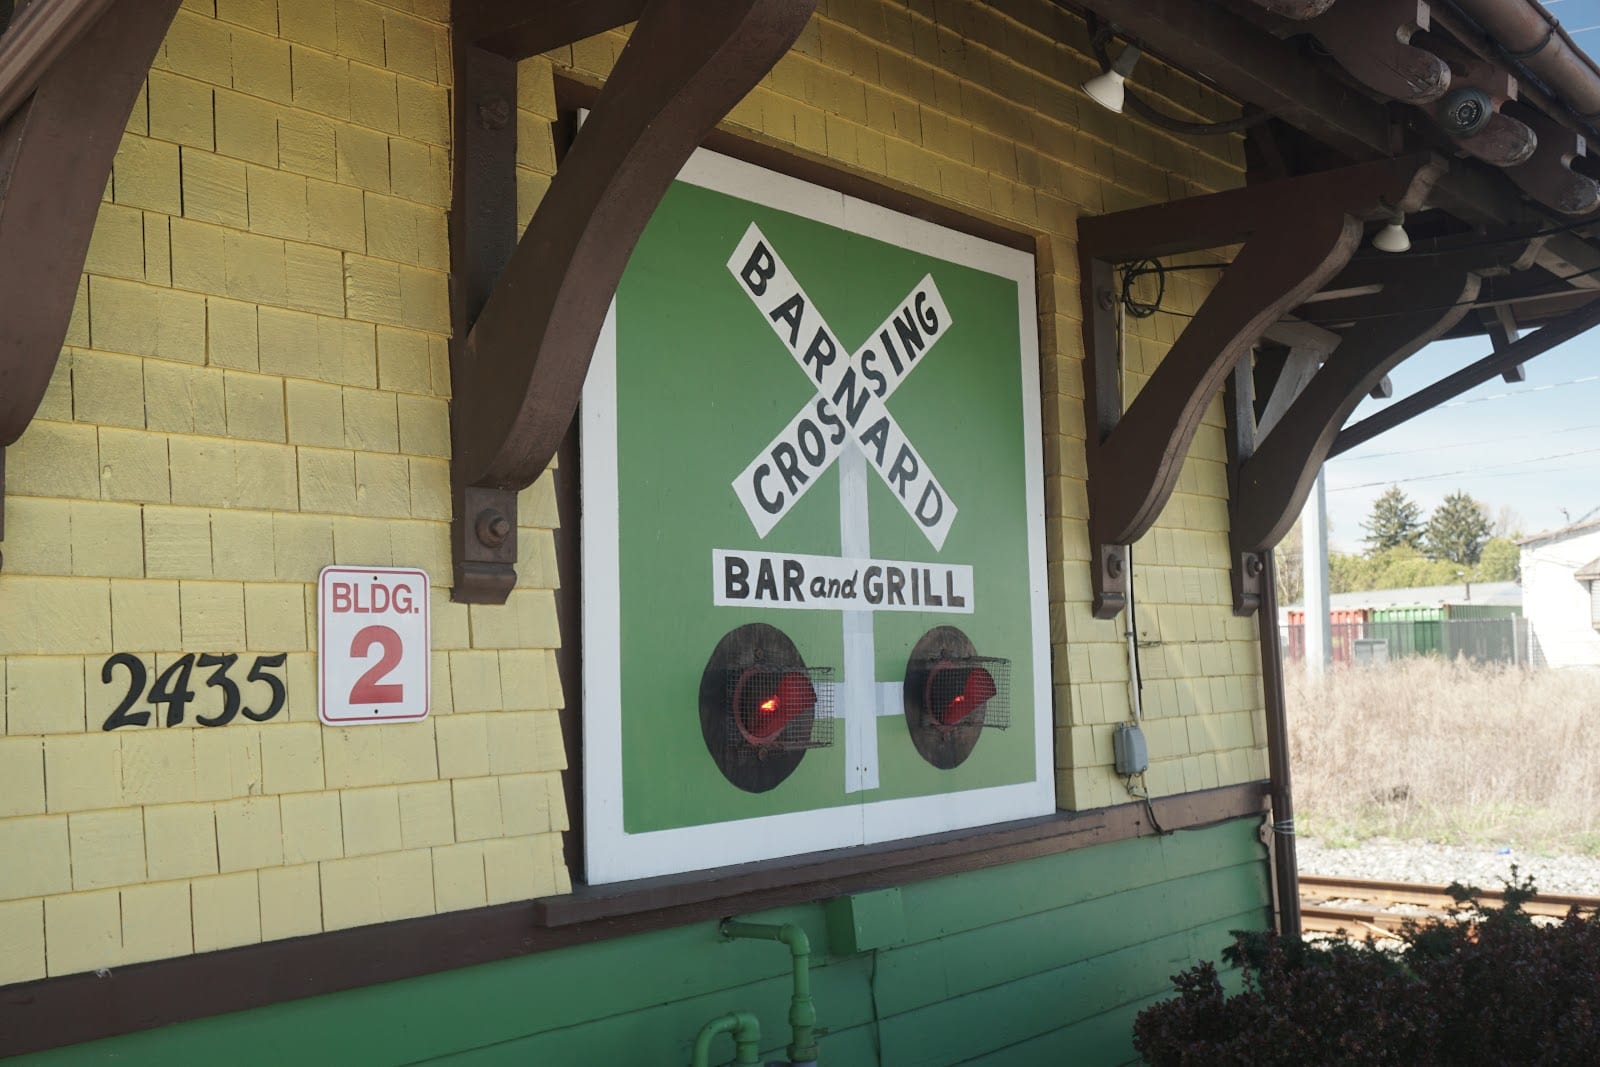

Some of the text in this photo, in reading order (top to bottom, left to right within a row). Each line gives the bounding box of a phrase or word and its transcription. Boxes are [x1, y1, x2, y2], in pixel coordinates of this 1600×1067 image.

[740, 240, 943, 527] BARNARD
[753, 291, 939, 514] CROSSING
[332, 582, 420, 614] BLDG.
[724, 556, 965, 607] BAR and GRILL
[102, 652, 287, 731] 2435
[349, 625, 403, 705] 2
